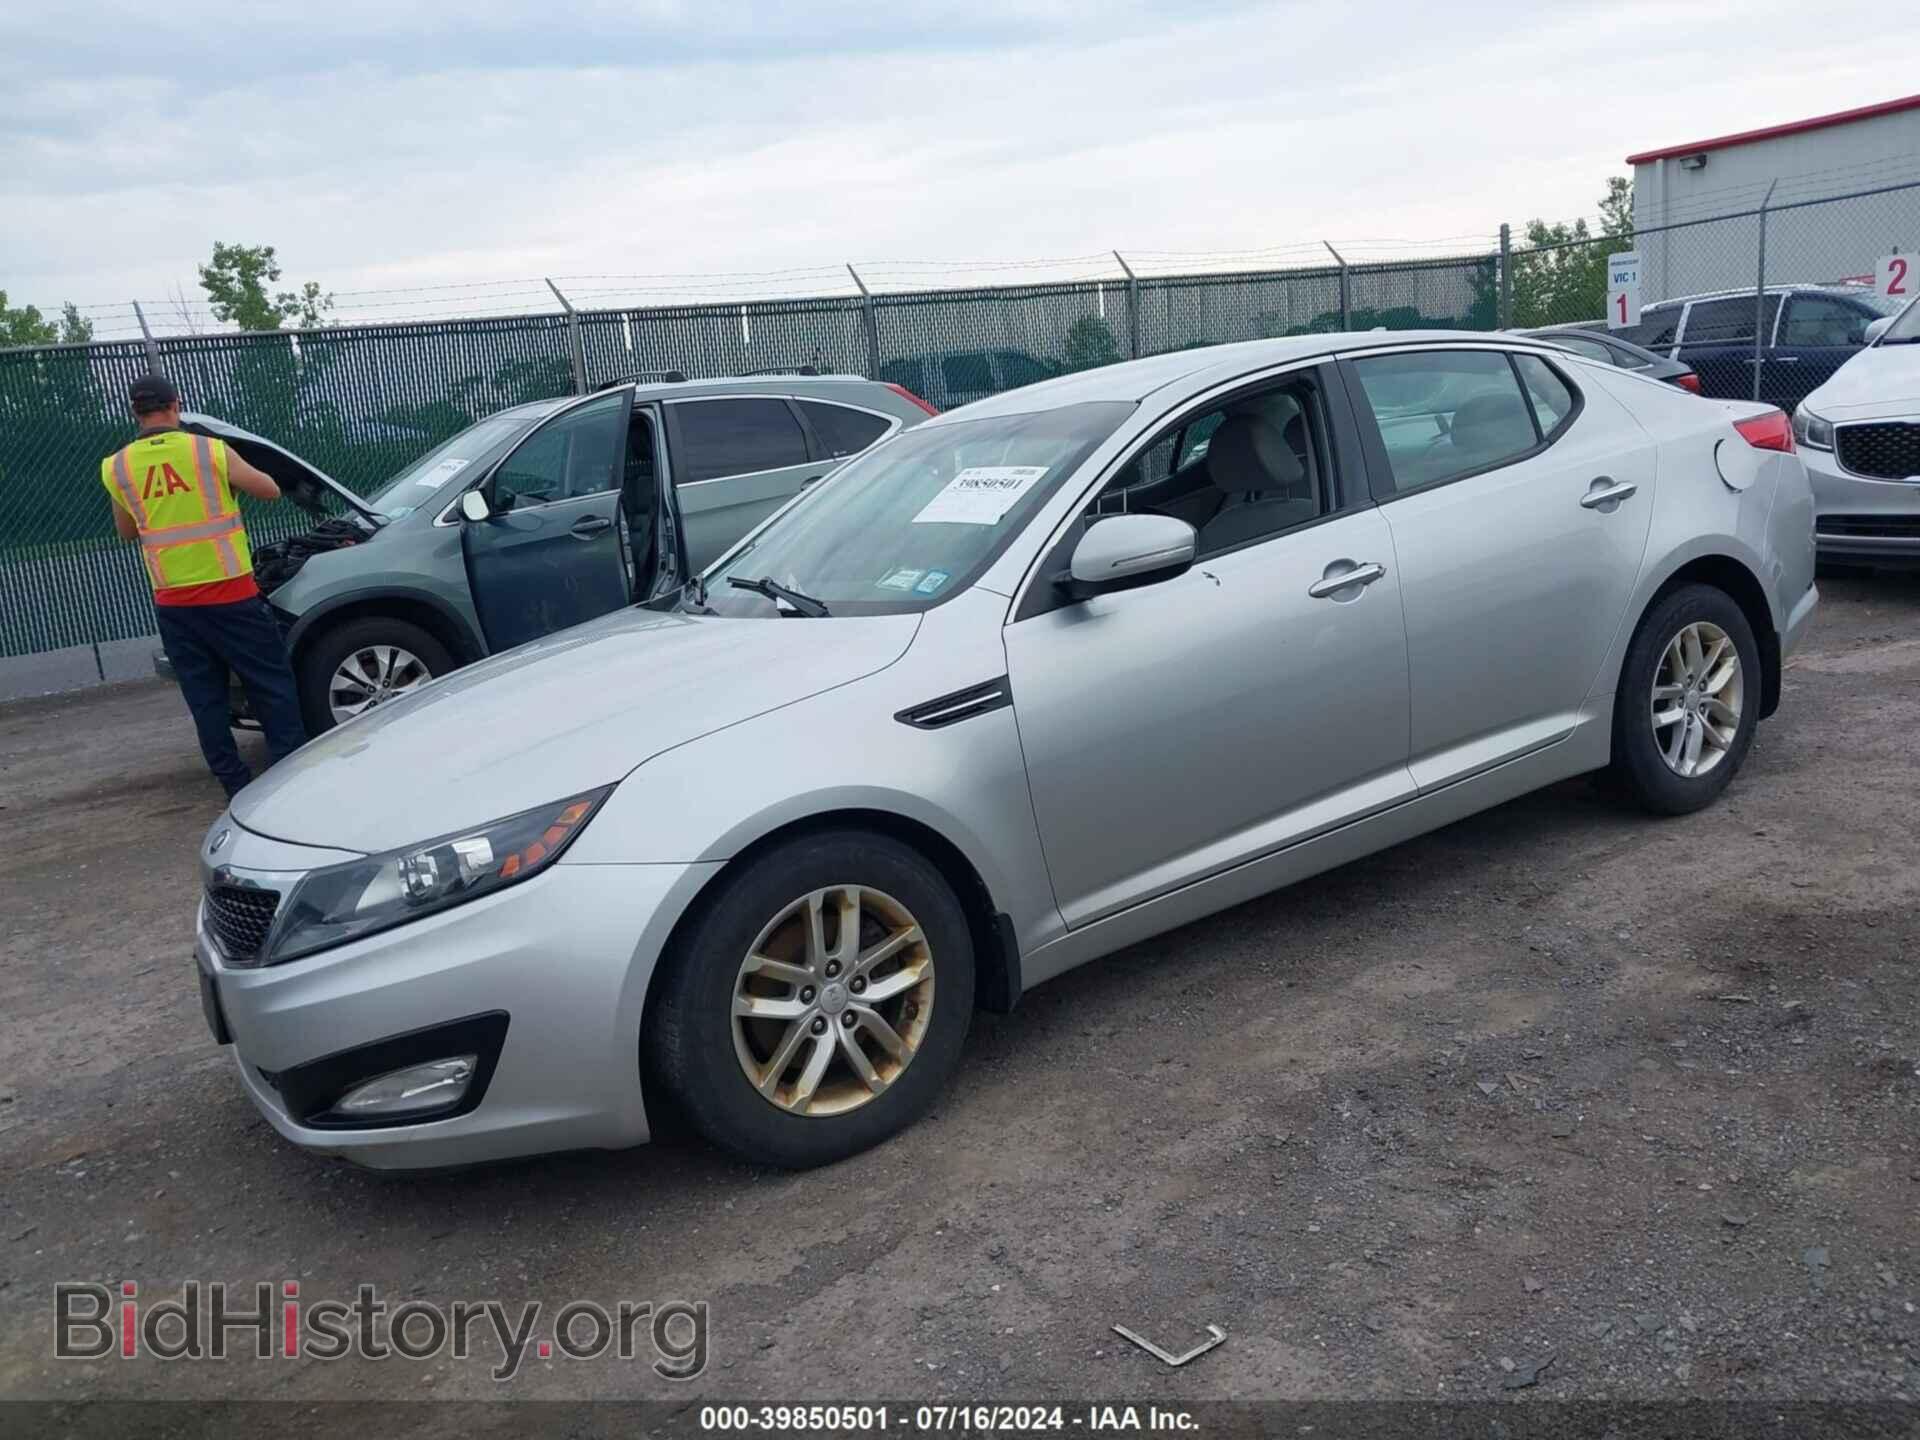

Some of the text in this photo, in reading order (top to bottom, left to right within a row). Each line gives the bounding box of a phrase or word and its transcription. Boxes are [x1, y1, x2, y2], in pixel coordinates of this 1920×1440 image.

[1613, 271, 1636, 284] VIC 1
[1887, 258, 1907, 295] 2
[1616, 293, 1627, 324] 1
